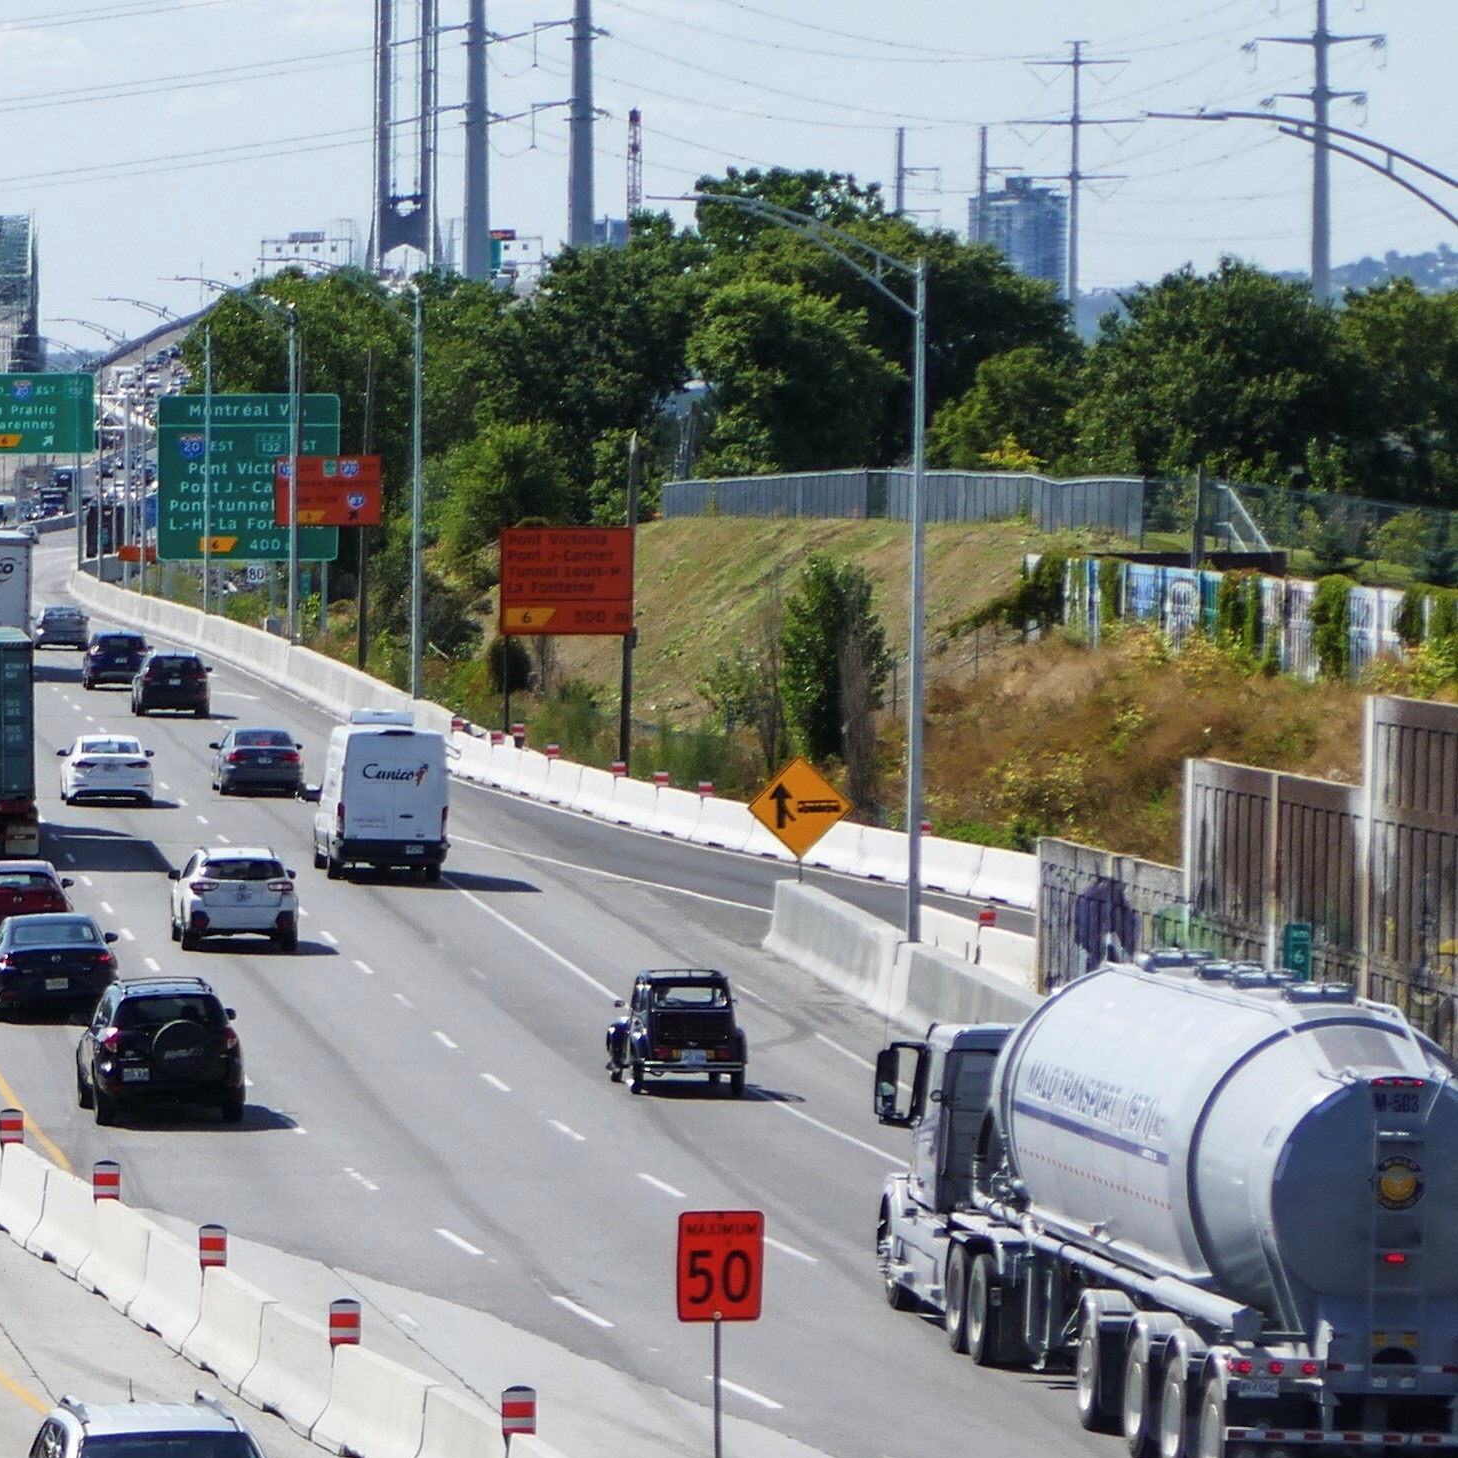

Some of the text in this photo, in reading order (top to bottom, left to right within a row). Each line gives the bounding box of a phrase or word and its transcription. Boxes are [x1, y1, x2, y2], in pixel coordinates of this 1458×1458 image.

[16, 387, 29, 396] 20
[35, 386, 56, 396] EST
[11, 405, 57, 415] Prairie
[189, 404, 269, 417] Mntréal
[184, 443, 200, 452] 20
[210, 441, 234, 451] EST
[262, 442, 280, 452] 132
[180, 482, 219, 494] Pot
[212, 540, 220, 550] 6
[250, 539, 281, 550] 400
[508, 534, 608, 546] Pont Victoria
[508, 550, 540, 561] Pont
[249, 567, 264, 581] 80
[508, 566, 558, 578] Tunnel
[508, 582, 596, 594] La Fontaine
[522, 612, 532, 624] 6
[575, 610, 606, 623] 500
[362, 763, 415, 782] Cunico
[1293, 930, 1308, 938] km
[1294, 950, 1304, 964] 6
[1056, 1067, 1122, 1124] TRANSPORT
[689, 1249, 752, 1305] 50
